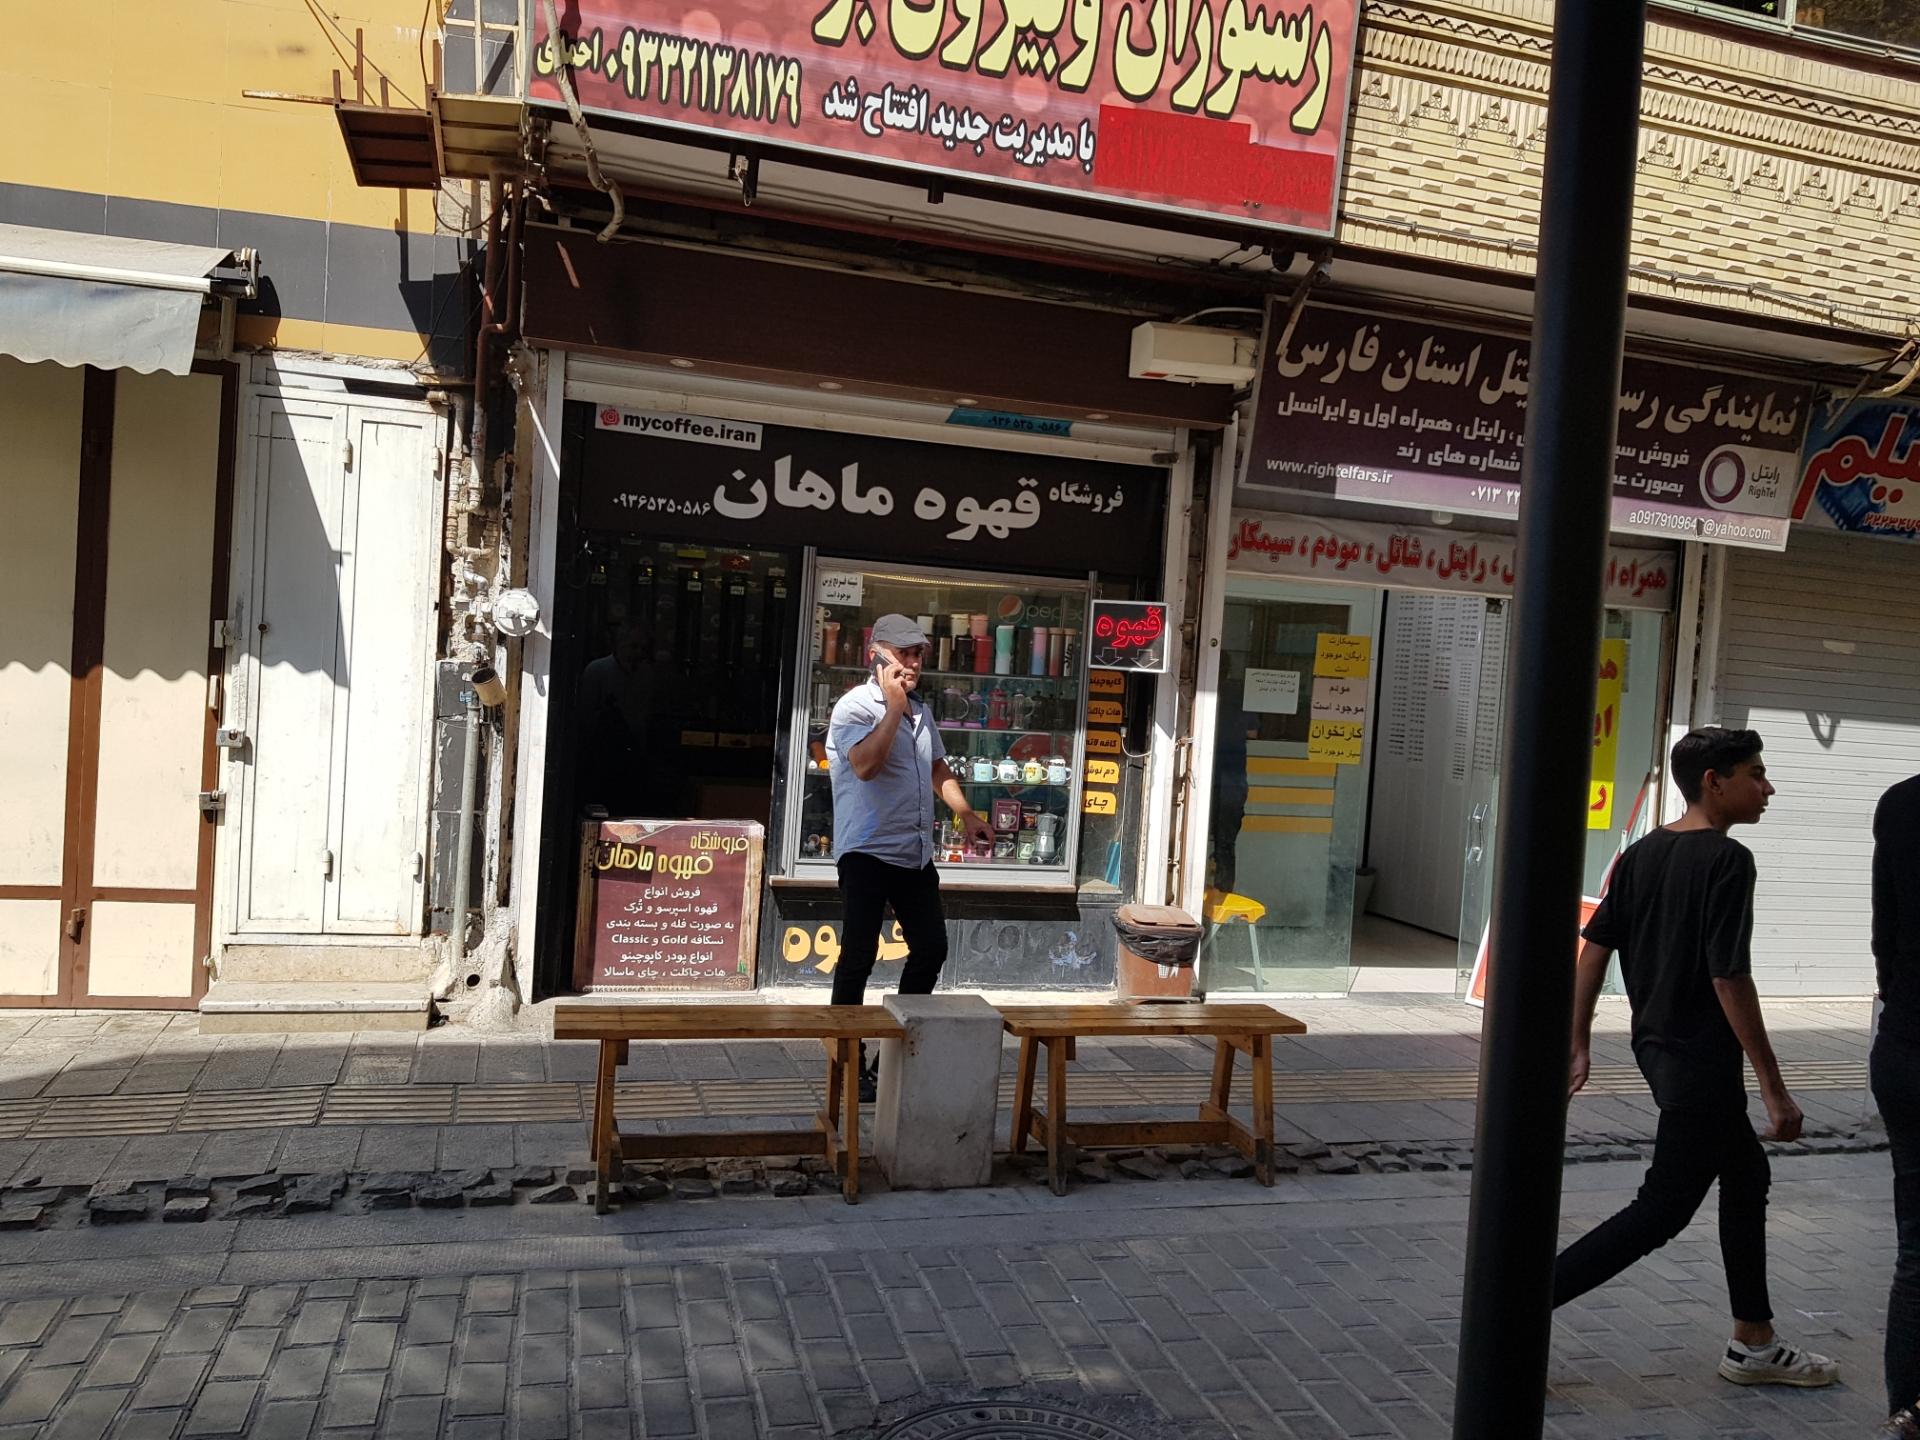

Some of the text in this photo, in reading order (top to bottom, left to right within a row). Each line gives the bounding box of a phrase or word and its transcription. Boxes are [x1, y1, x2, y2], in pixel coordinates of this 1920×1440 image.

[822, 75, 862, 121] شد
[861, 81, 929, 136] افتتاح
[930, 101, 991, 154] جدید
[994, 113, 1075, 168] مدیریت
[1076, 118, 1096, 175] با
[1276, 324, 1381, 384] فارس
[1381, 334, 1482, 392] استان
[1277, 391, 1347, 422] ایرانسل
[1348, 406, 1359, 425] و
[1363, 403, 1397, 429] اول
[1663, 385, 1800, 441] نمایندگی
[622, 411, 757, 444] mycoffee.iran
[1399, 409, 1453, 433] همراه
[1396, 442, 1521, 472] شماره های رند
[1637, 442, 1690, 468] فروش
[1266, 458, 1393, 485] www.rightelfars.ir
[712, 454, 1042, 541] قهوه ماهان
[1049, 481, 1125, 514] فروشگاه
[1630, 472, 1684, 498] بصورت
[1629, 509, 1772, 540] a0917910964@yahoo.com
[1310, 534, 1360, 569] مودم
[1095, 605, 1162, 648] قهوه
[1083, 797, 1109, 811] چای
[690, 831, 750, 855] فروشگاه
[593, 838, 714, 880] قهوه ماهان
[644, 886, 701, 899] فروش انواع
[655, 903, 692, 917] اسپرسو
[694, 903, 718, 915] قهوه
[606, 918, 632, 930] بندی
[634, 919, 658, 930] بسته
[689, 919, 722, 931] صورت
[724, 920, 735, 932] به
[611, 933, 649, 944] Classic
[661, 934, 688, 945] Gold
[690, 934, 725, 945] نسکافه
[619, 951, 713, 965] انواع پودر کاپوچینو
[637, 967, 660, 980] چای
[669, 967, 701, 980] چاکلت
[703, 967, 726, 977] هات
